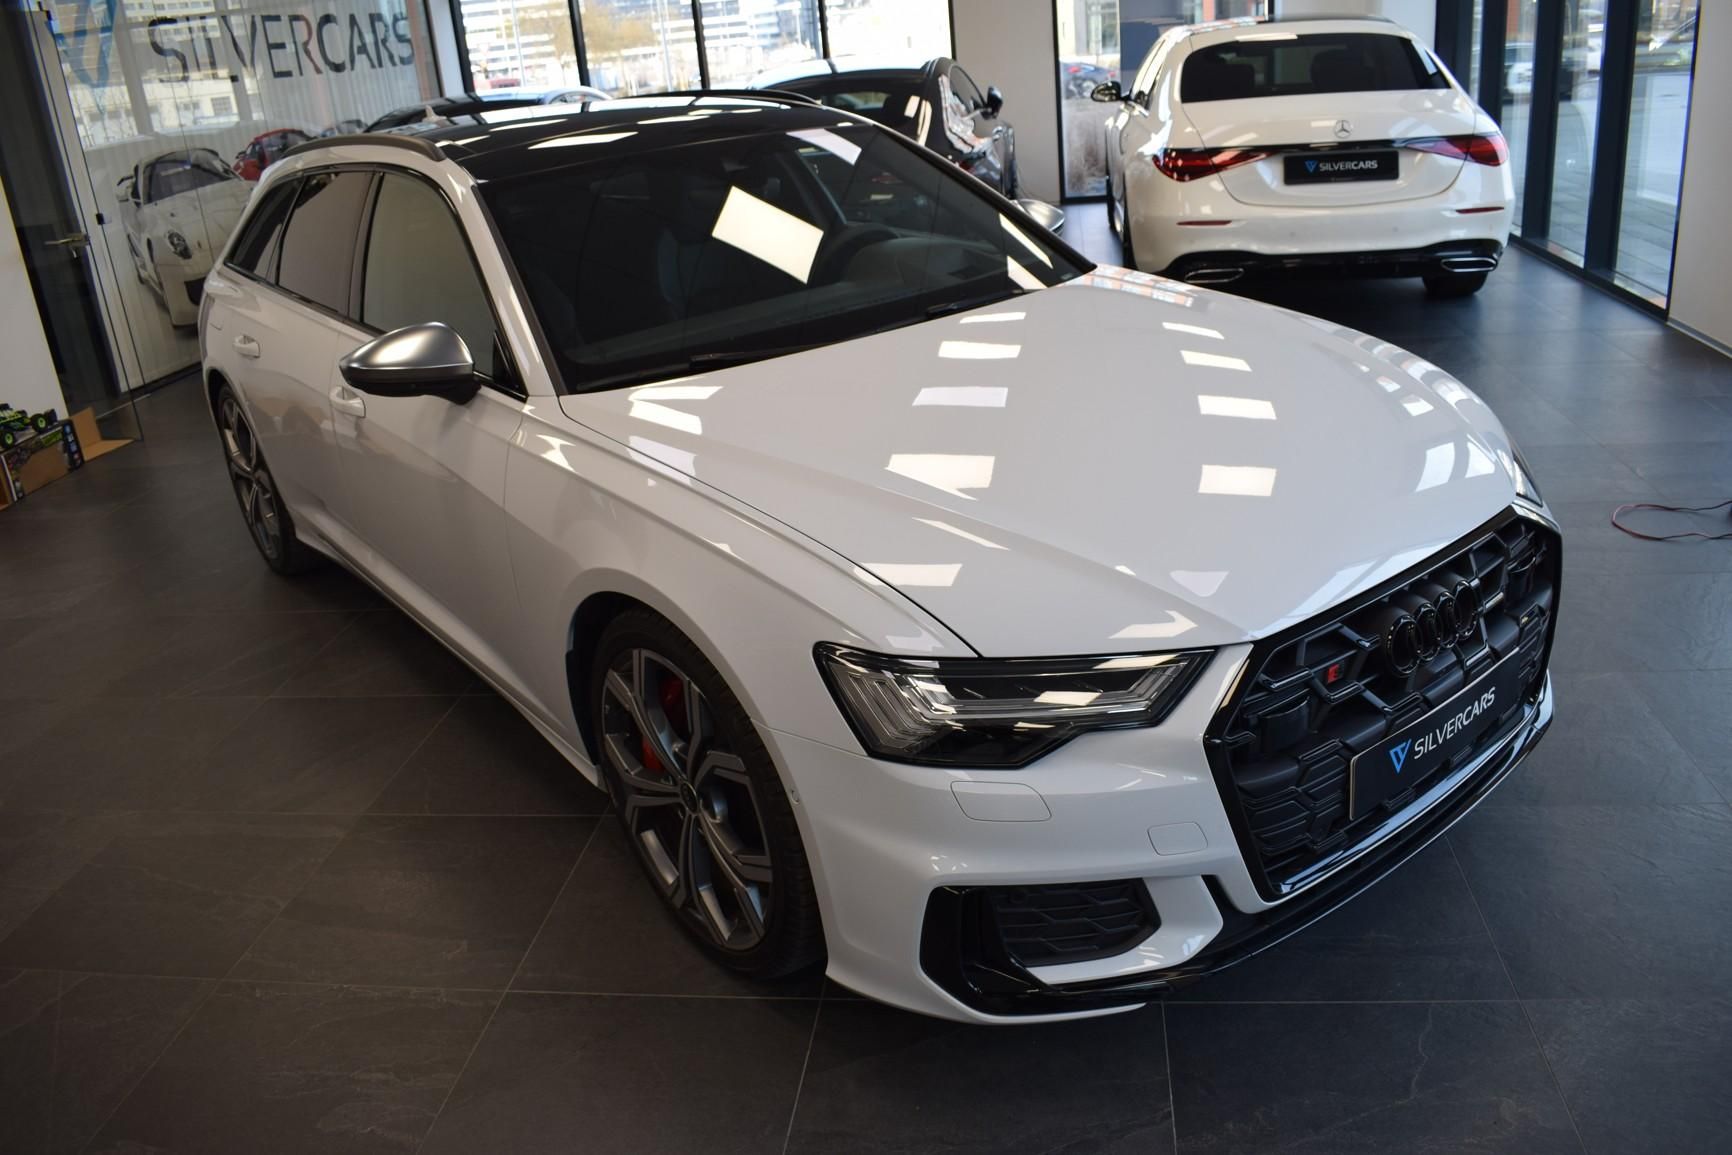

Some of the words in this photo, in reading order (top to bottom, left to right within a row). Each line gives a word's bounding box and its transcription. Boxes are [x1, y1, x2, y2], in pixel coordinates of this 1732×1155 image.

[148, 13, 414, 82] SILVERCARS
[1319, 160, 1378, 171] SILVERCARS
[1414, 686, 1496, 760] SILVERCARS
